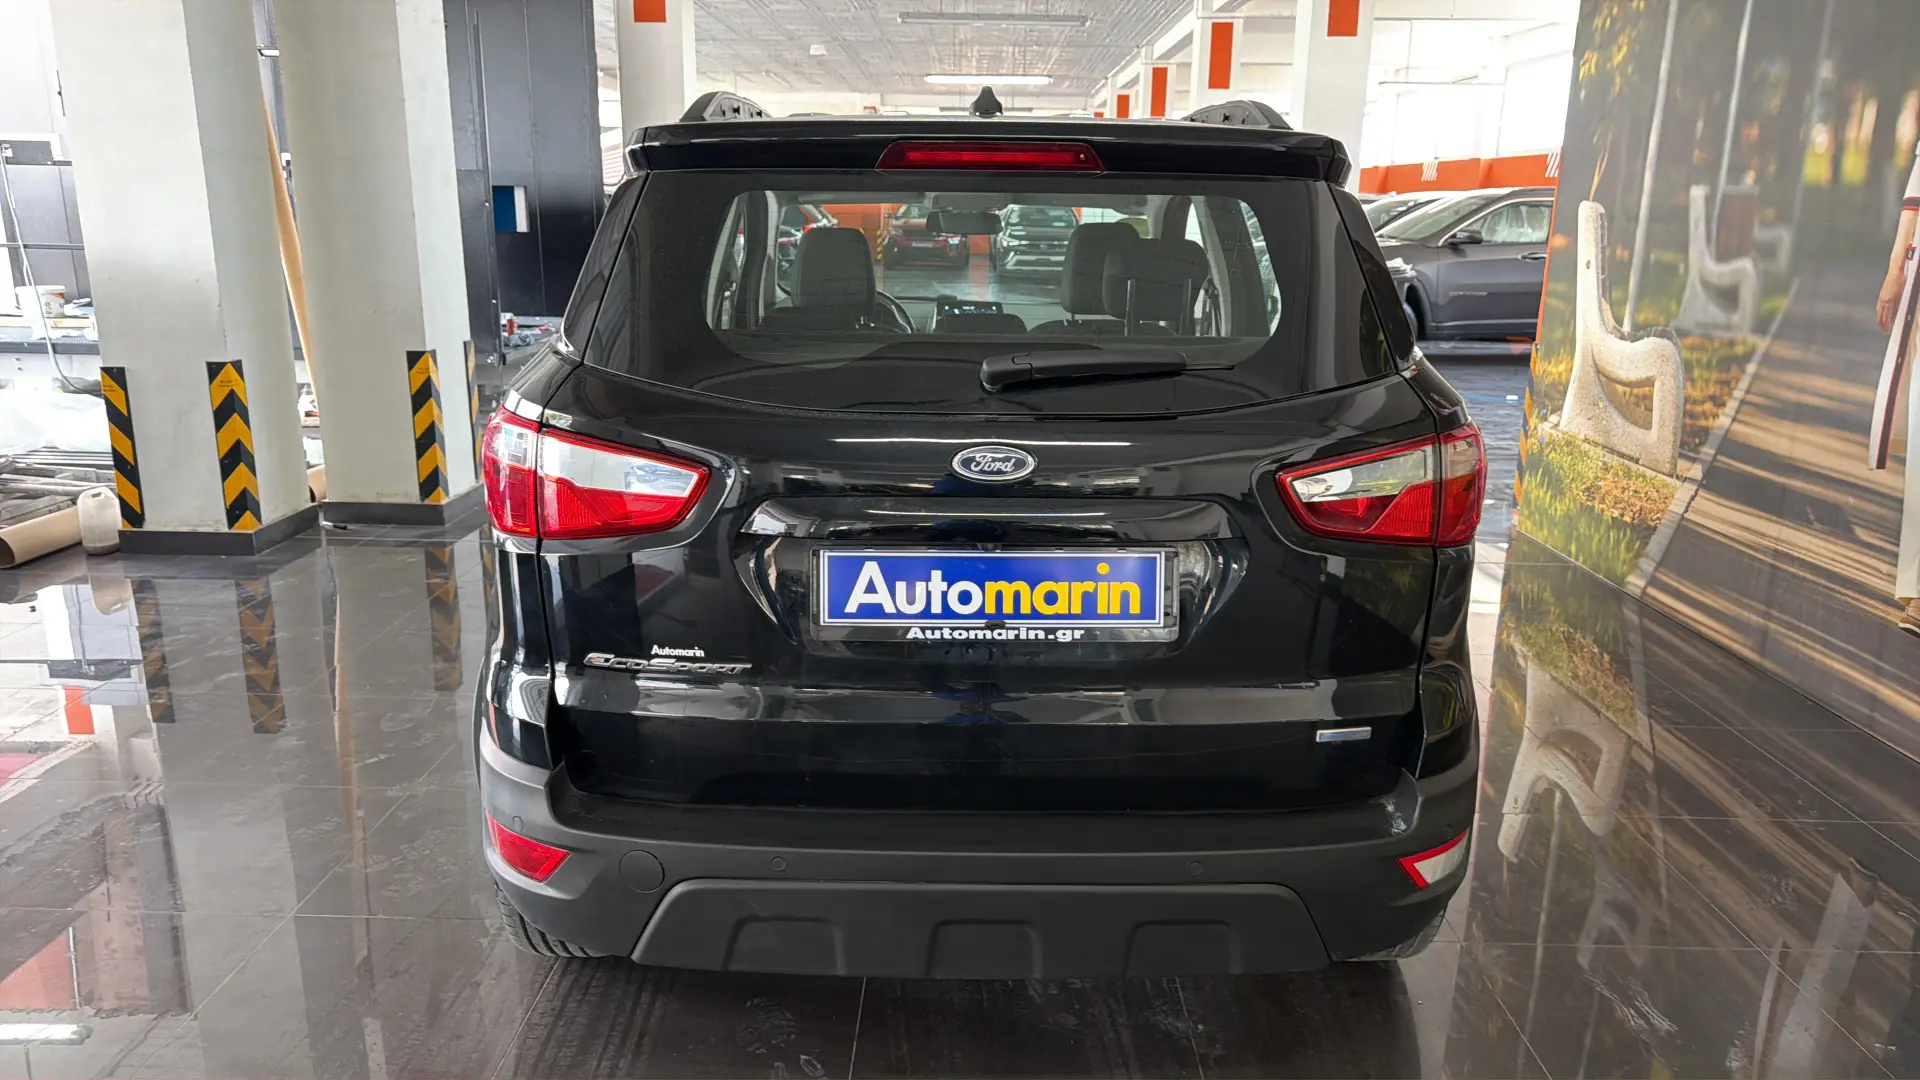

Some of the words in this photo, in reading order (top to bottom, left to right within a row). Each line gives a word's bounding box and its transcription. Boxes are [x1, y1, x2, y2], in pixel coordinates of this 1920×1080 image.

[970, 453, 1015, 472] Ford
[844, 560, 1141, 615] Automarin
[906, 626, 1085, 642] Automarin.gr
[651, 644, 705, 657] Automarin
